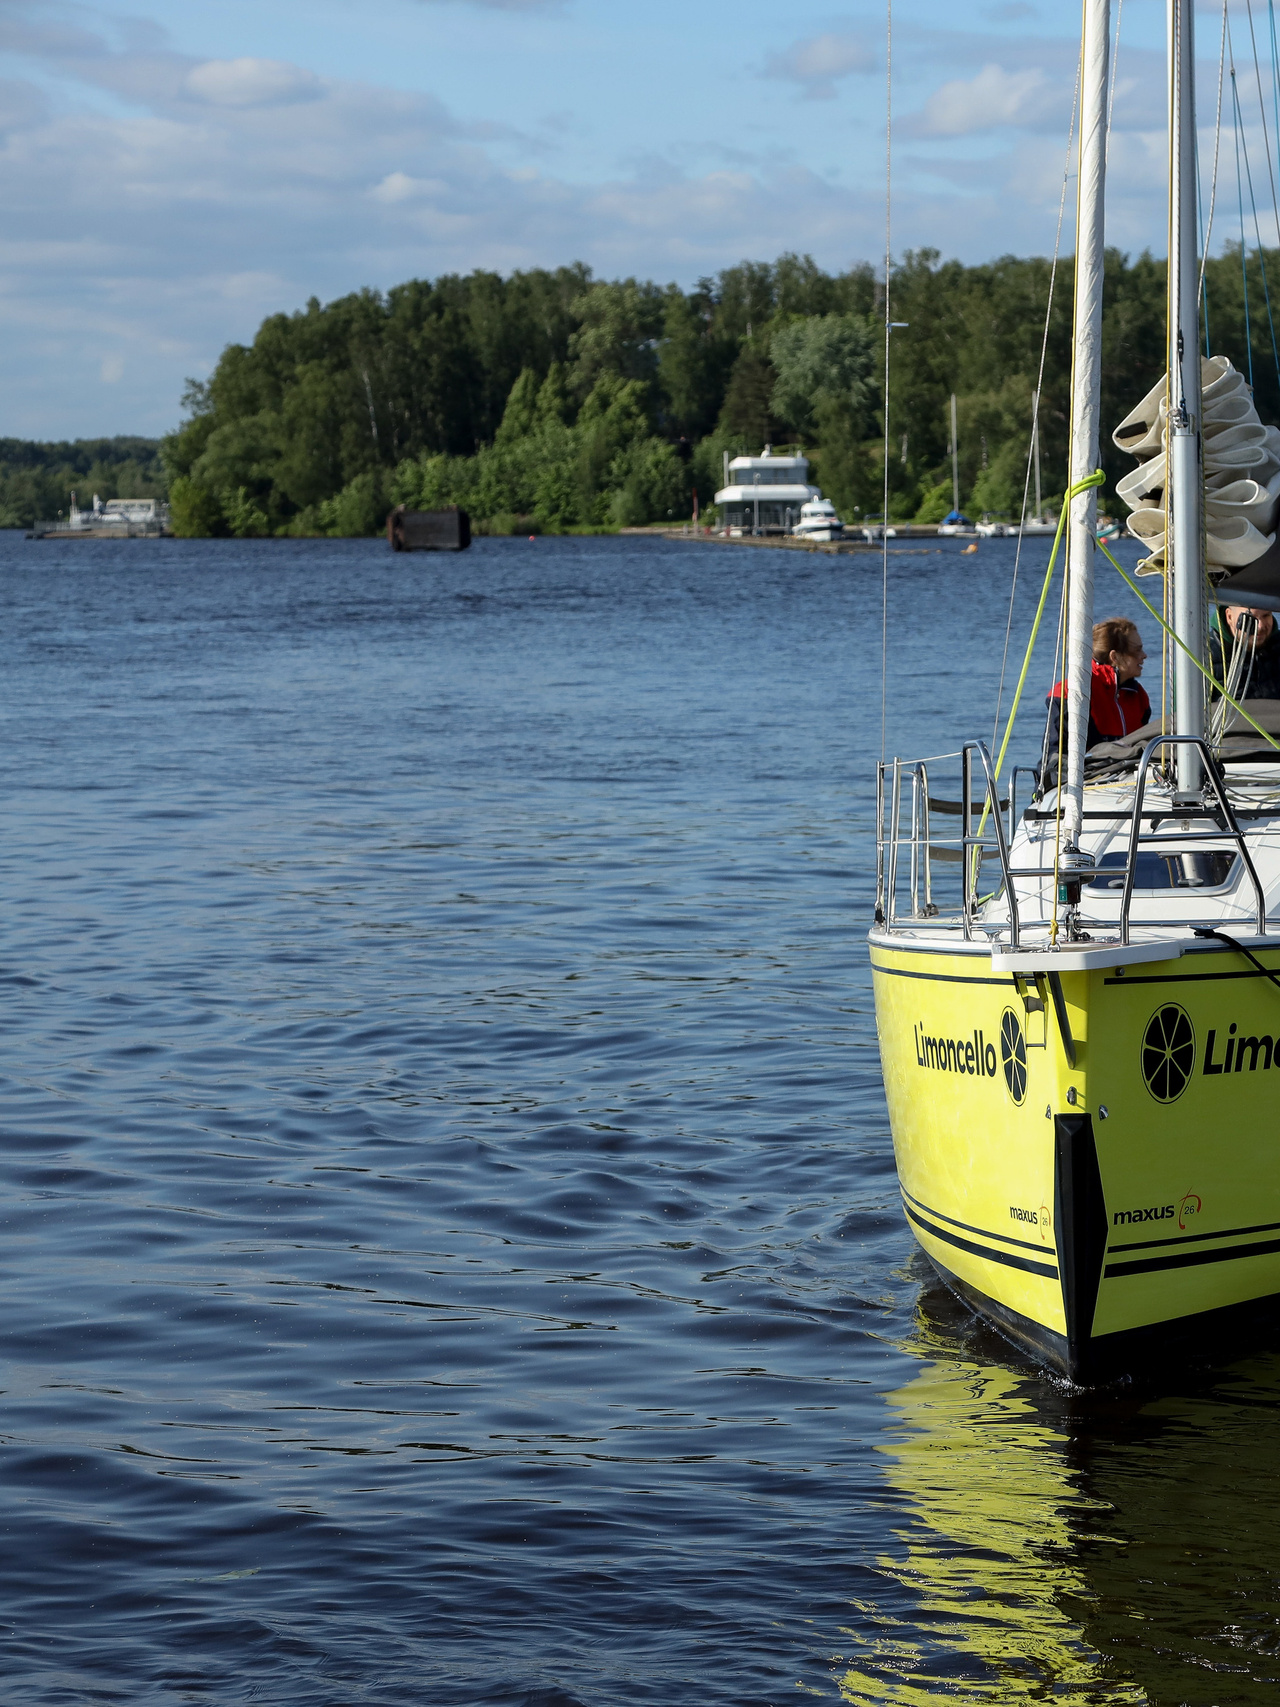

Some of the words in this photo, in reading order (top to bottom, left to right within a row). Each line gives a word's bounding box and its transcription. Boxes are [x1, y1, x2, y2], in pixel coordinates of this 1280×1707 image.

[914, 1020, 997, 1077] Limoncello
[1009, 1205, 1038, 1225] maxus
[1113, 1204, 1175, 1225] maxus
[1184, 1205, 1195, 1215] 26
